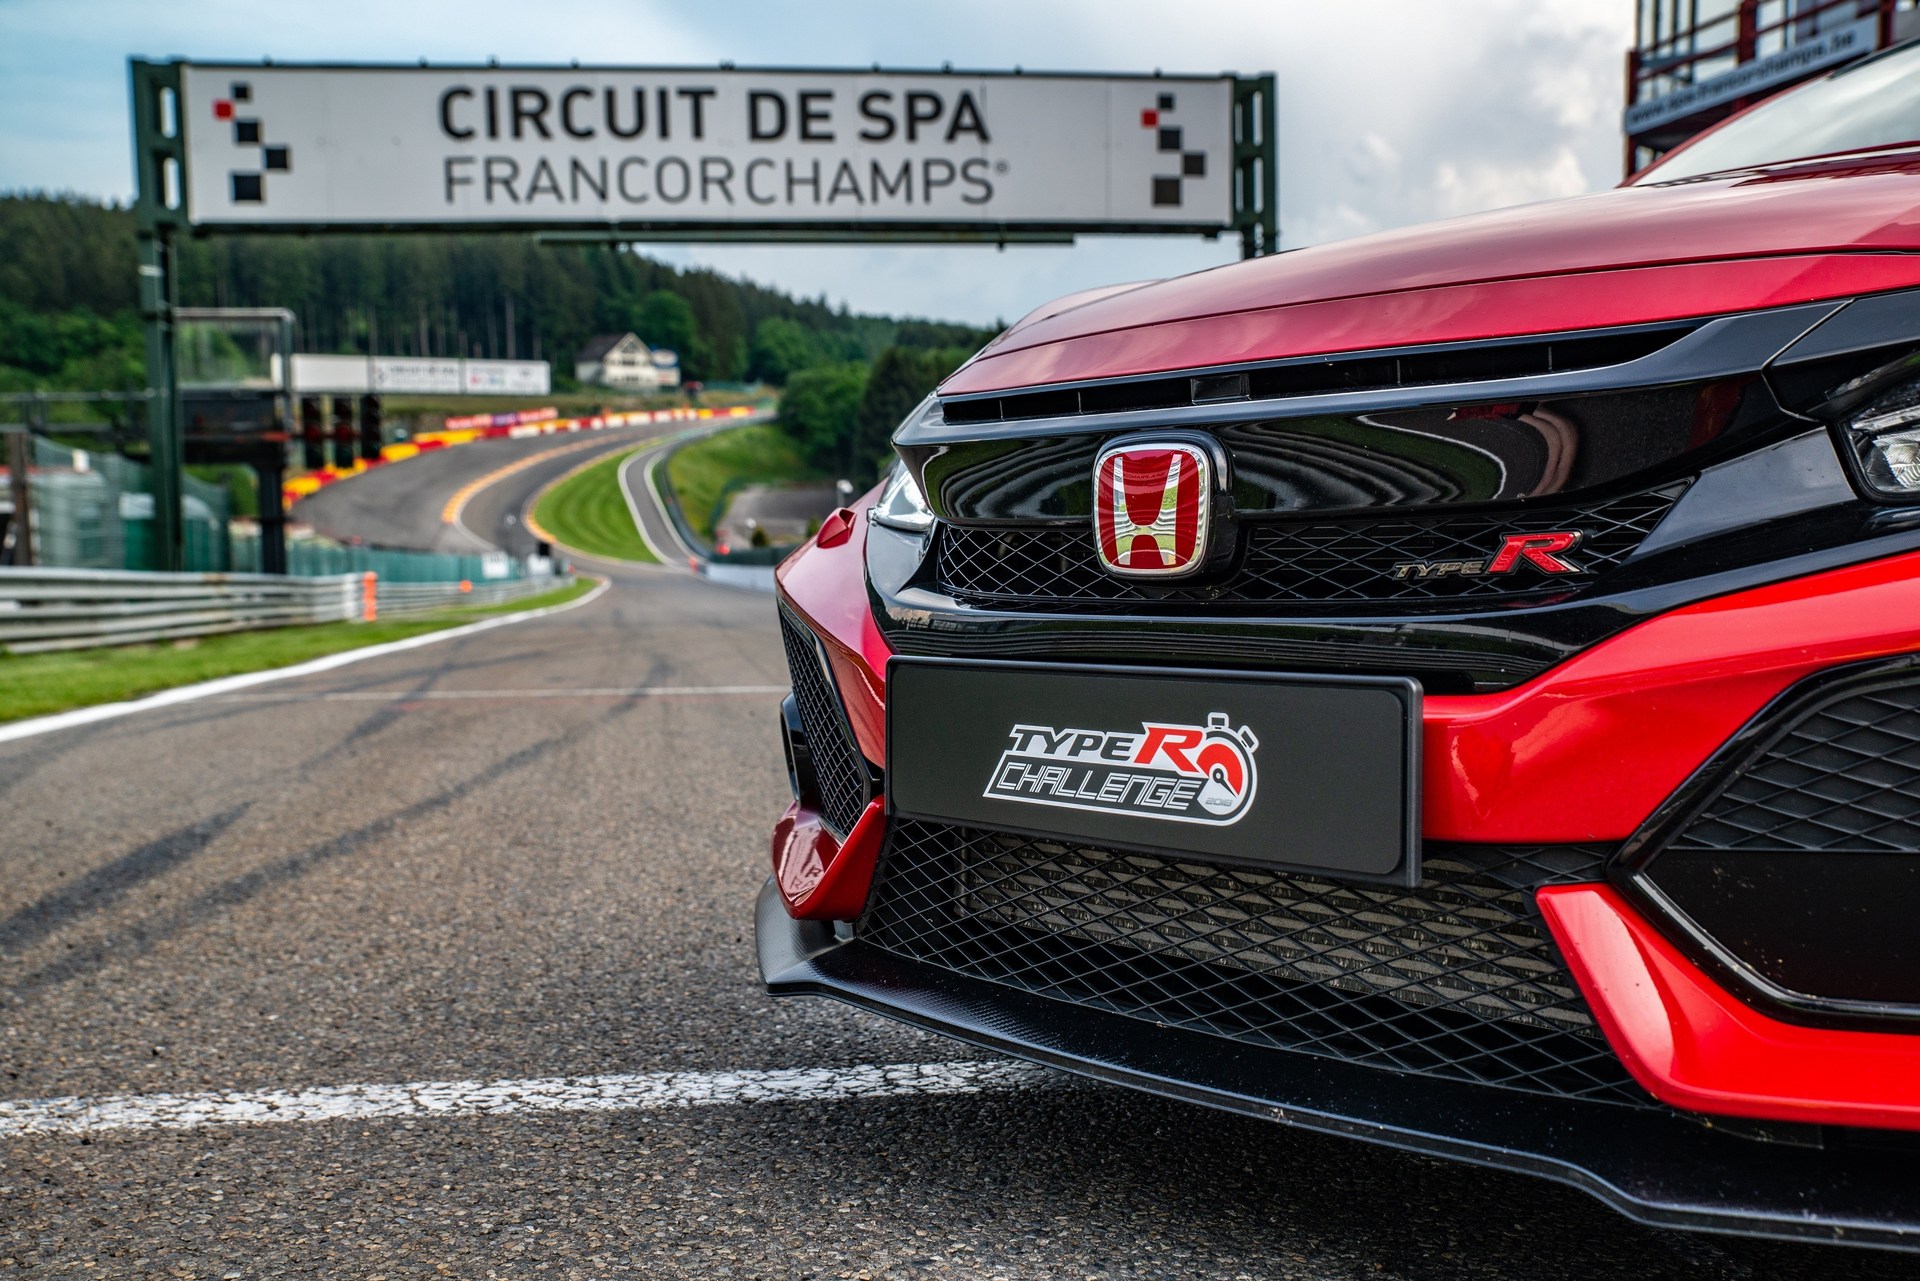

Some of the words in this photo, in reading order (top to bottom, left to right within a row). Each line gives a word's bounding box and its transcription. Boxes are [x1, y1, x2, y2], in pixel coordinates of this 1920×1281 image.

[437, 85, 718, 142] CIRCUIT
[746, 88, 836, 143] DE
[857, 88, 992, 145] SPA
[1394, 560, 1486, 578] TYPE
[1486, 530, 1584, 574] R
[1011, 726, 1136, 762] TYPE
[1133, 725, 1205, 774] R
[996, 761, 1203, 811] CHALLENGE
[1204, 796, 1234, 808] 2018
